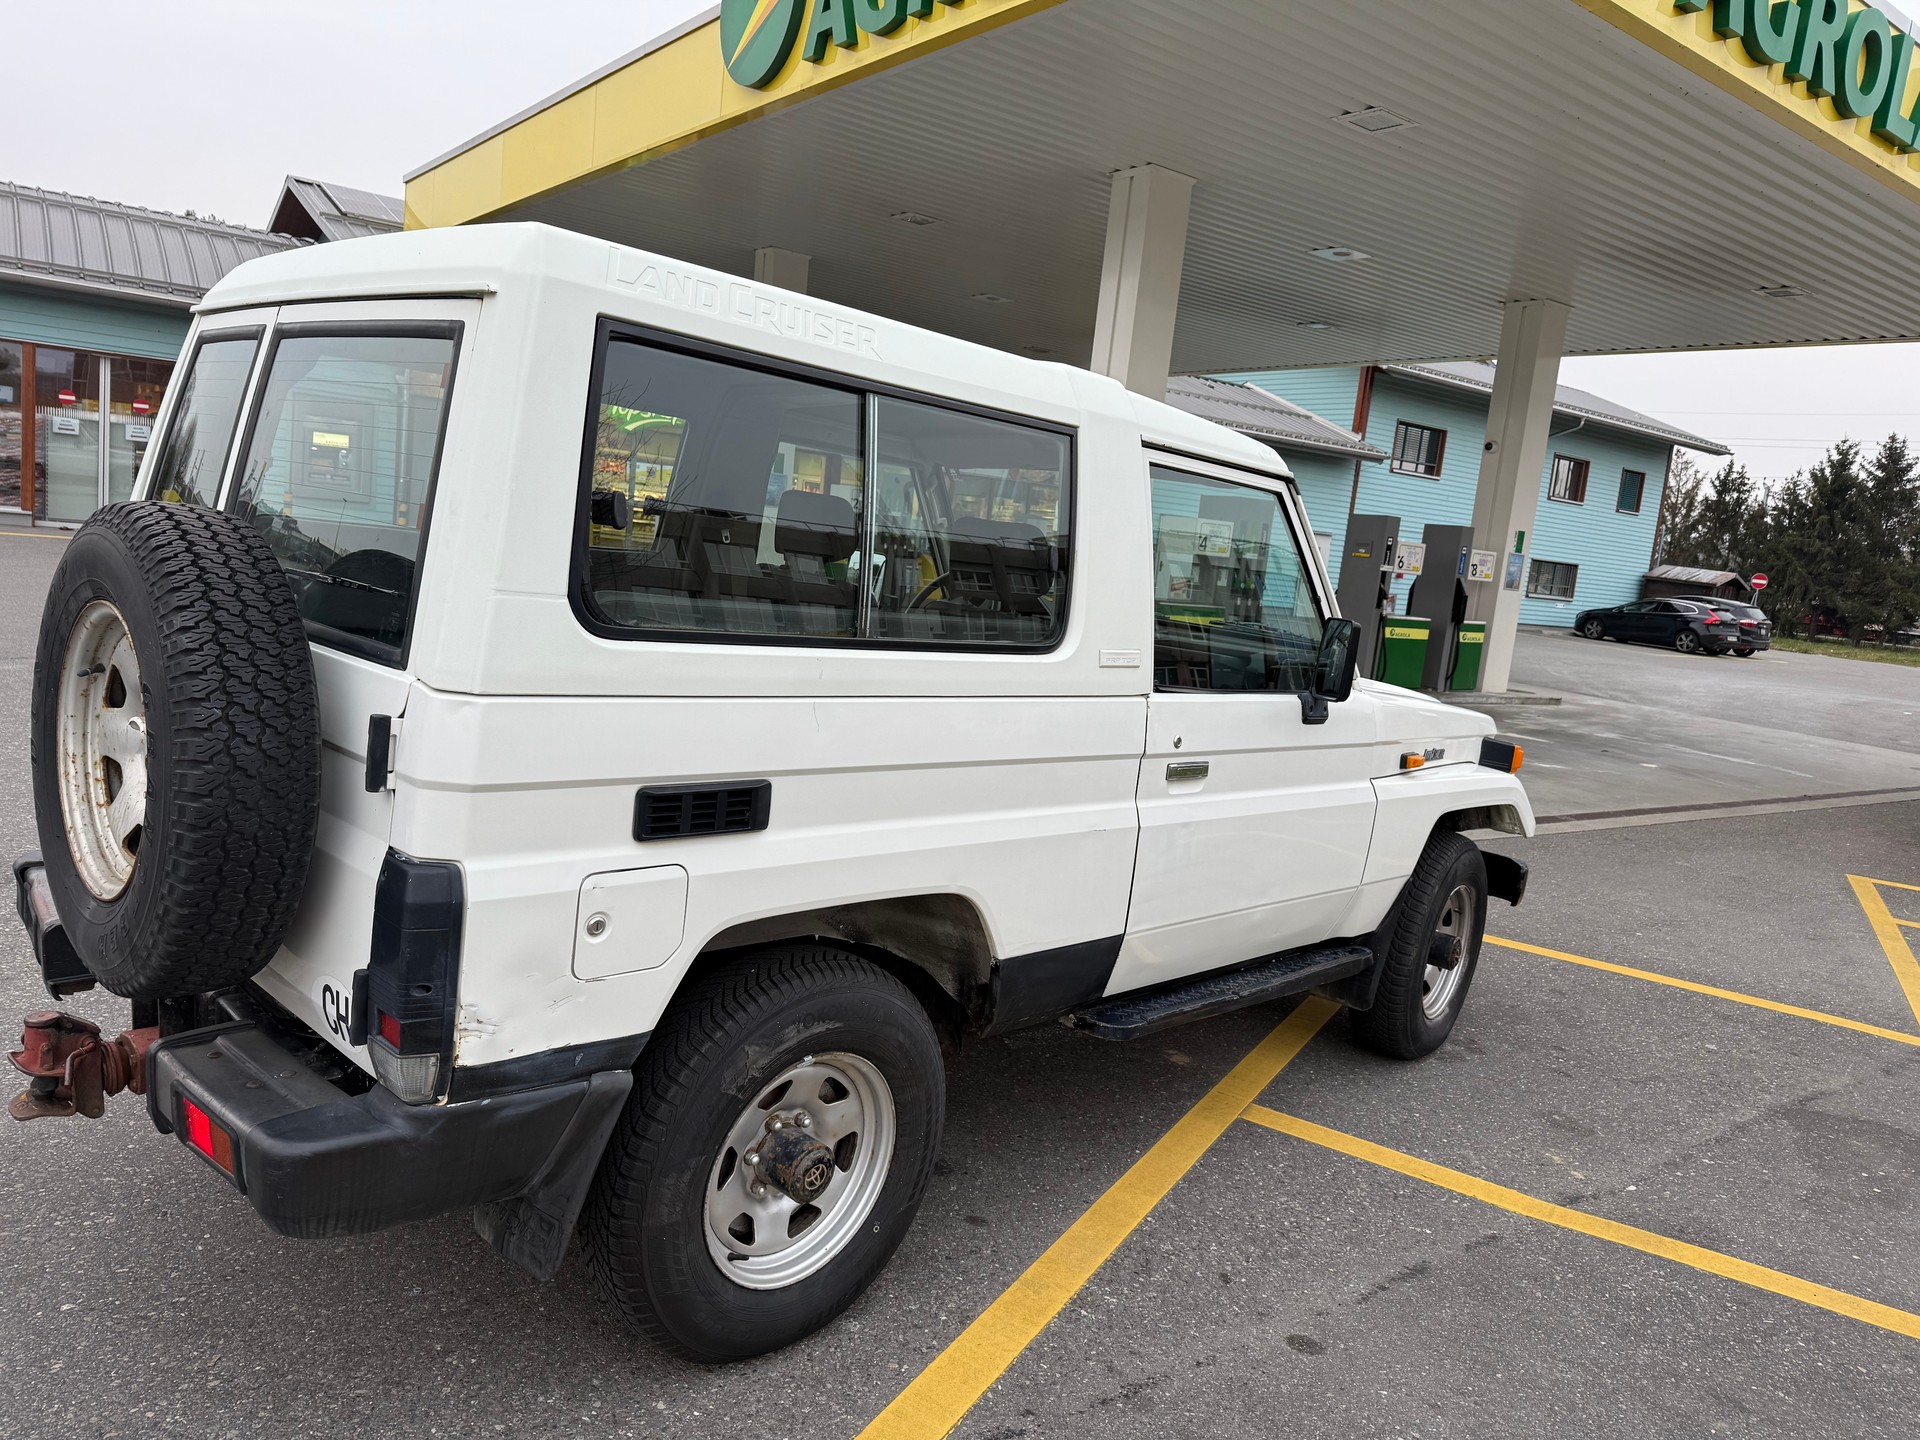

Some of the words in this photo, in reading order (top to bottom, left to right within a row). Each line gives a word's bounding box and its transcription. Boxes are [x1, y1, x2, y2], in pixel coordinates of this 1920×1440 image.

[1674, 0, 1920, 154] GROL
[605, 245, 720, 316] LAND
[728, 281, 884, 361] CRUISER
[322, 983, 355, 1048] CH
